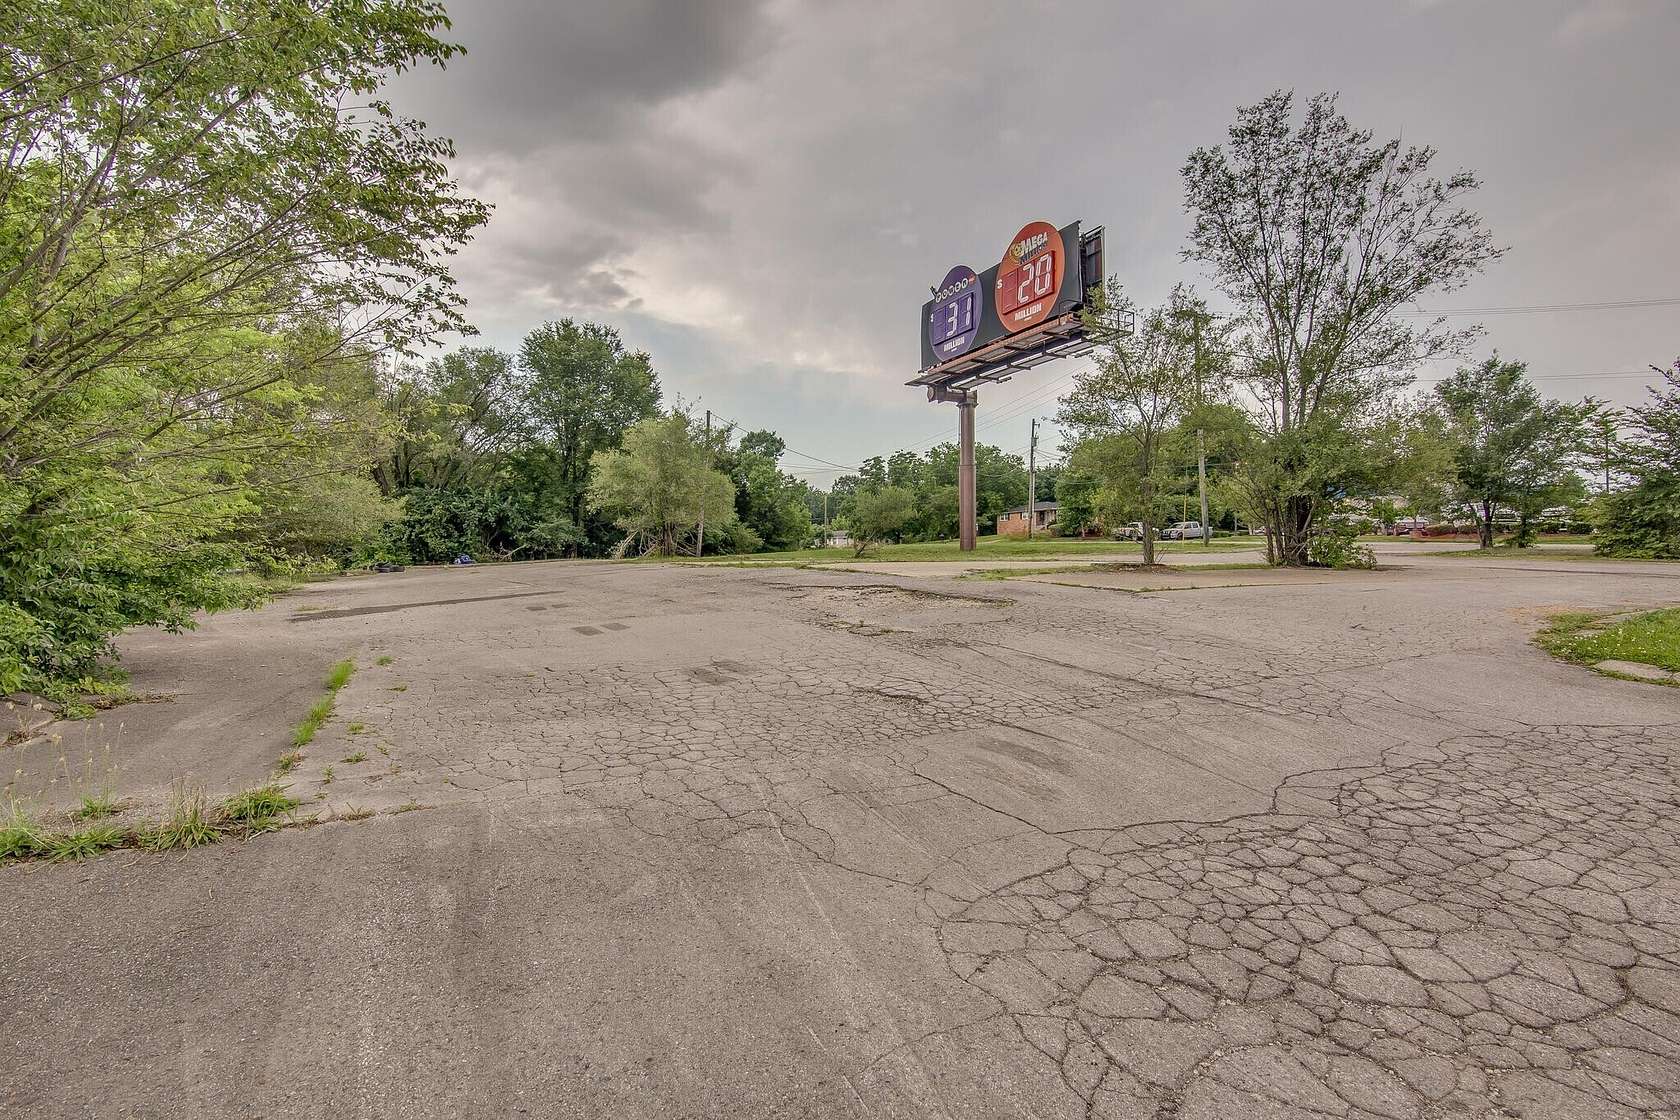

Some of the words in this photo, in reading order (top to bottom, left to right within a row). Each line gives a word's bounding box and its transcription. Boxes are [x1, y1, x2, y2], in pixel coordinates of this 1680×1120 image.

[1018, 232, 1048, 258] MEGA
[1018, 254, 1052, 303] 20
[946, 296, 972, 336] 31
[1014, 303, 1042, 321] MILLION
